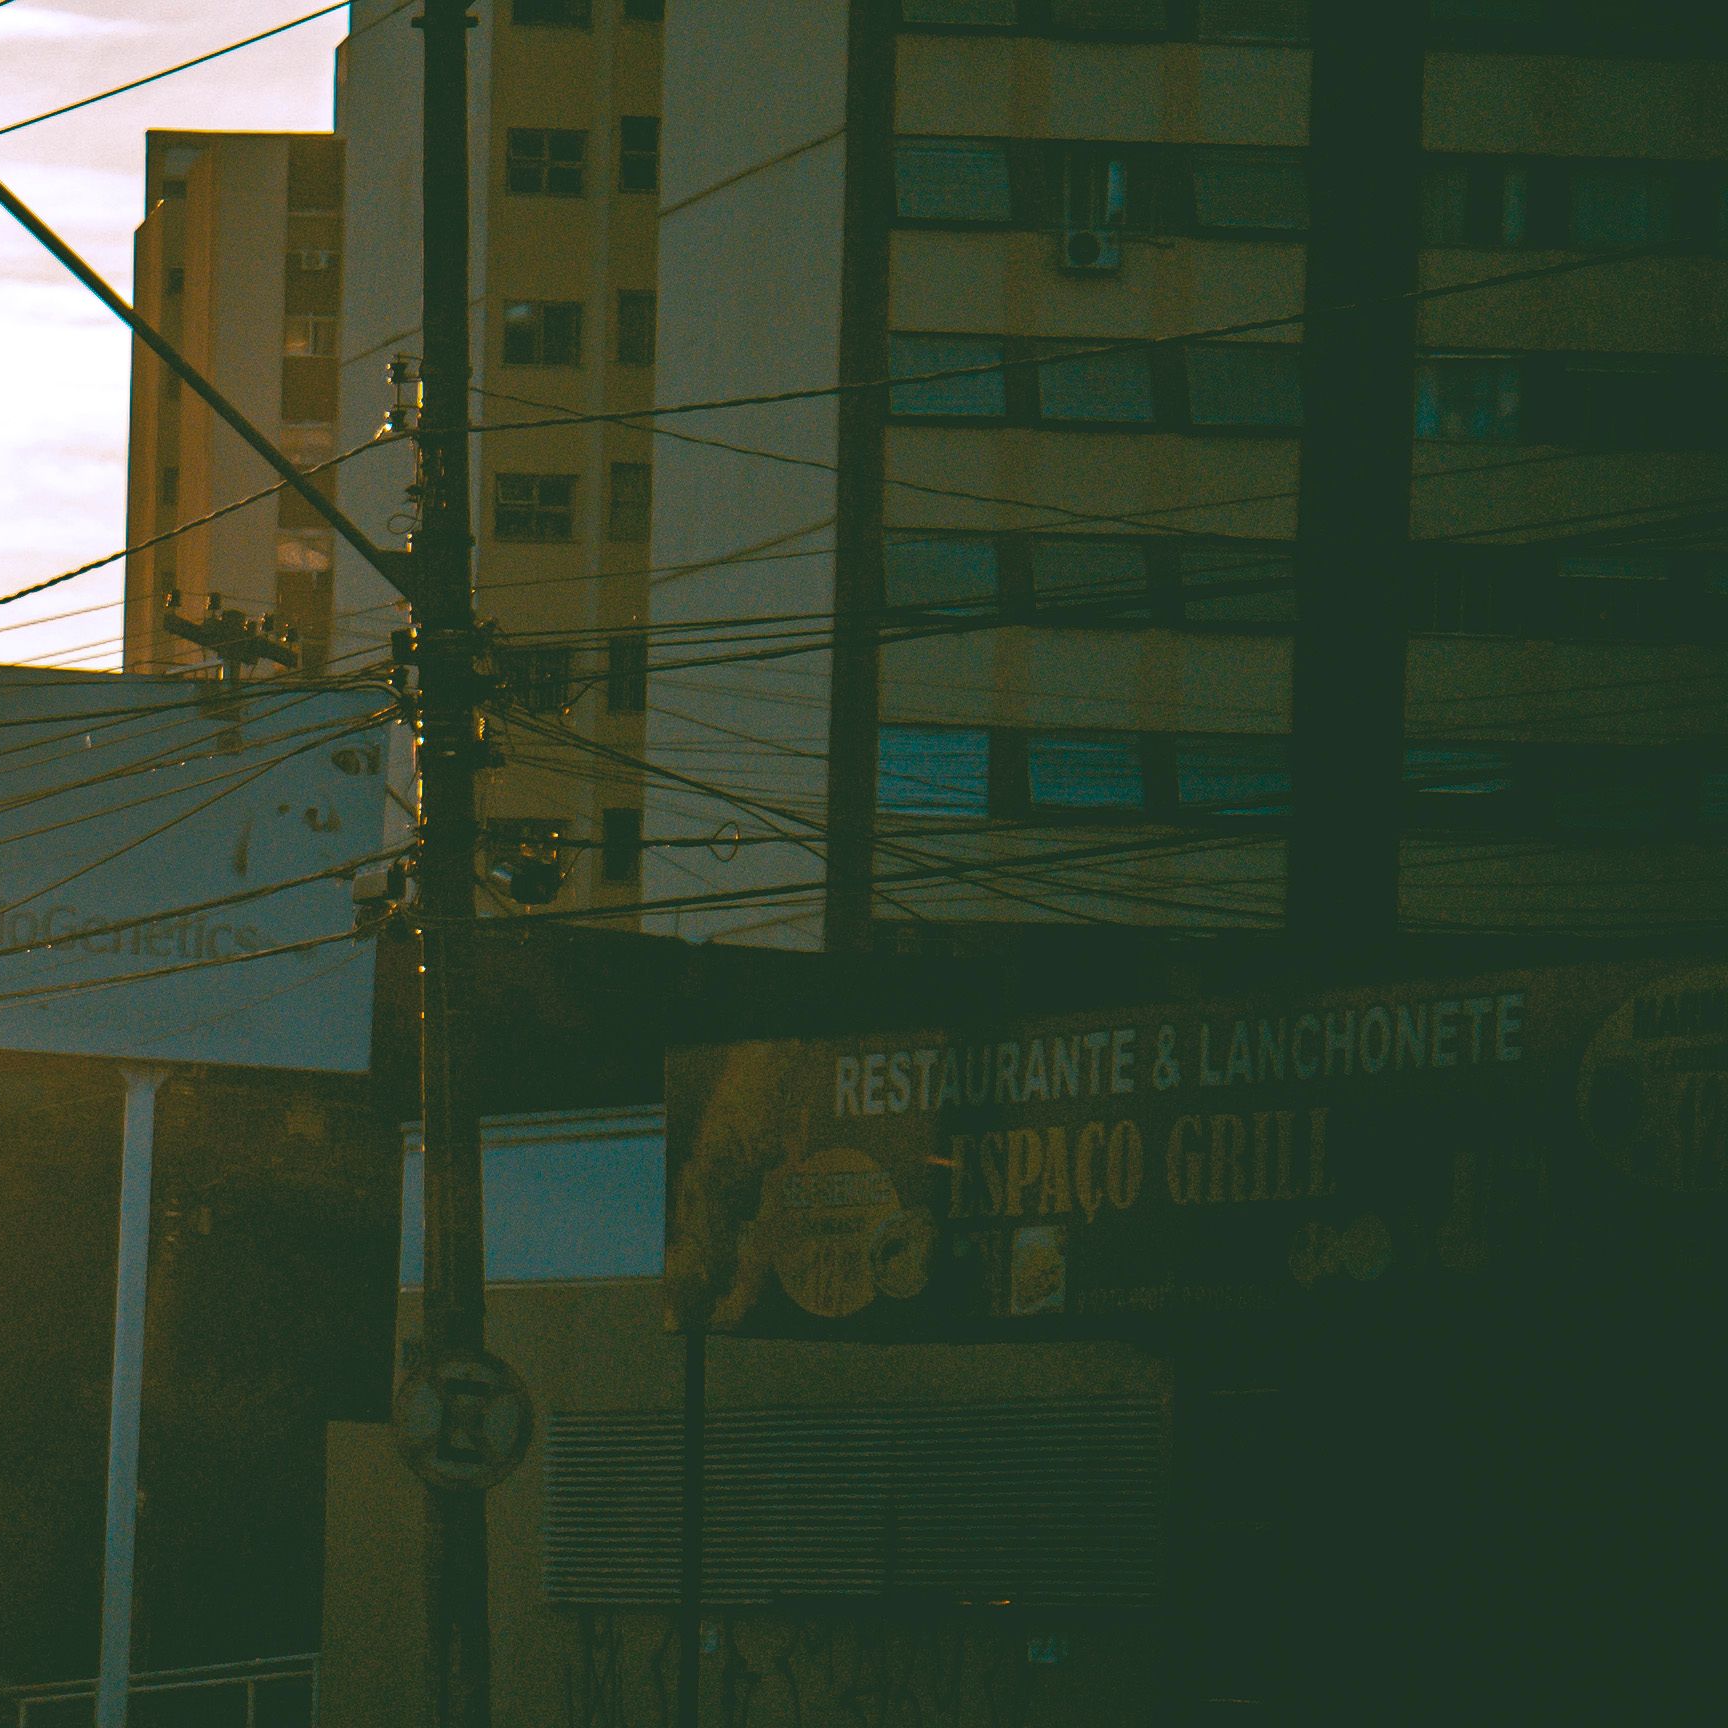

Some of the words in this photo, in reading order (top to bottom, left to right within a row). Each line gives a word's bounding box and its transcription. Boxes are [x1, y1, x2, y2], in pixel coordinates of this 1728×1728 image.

[835, 1029, 1136, 1118] RESTAURANTE
[1151, 1022, 1182, 1088] &
[1200, 993, 1525, 1086] LANCHONETE
[949, 1118, 1144, 1224] ESPAÇO
[1167, 1107, 1340, 1205] GRILL
